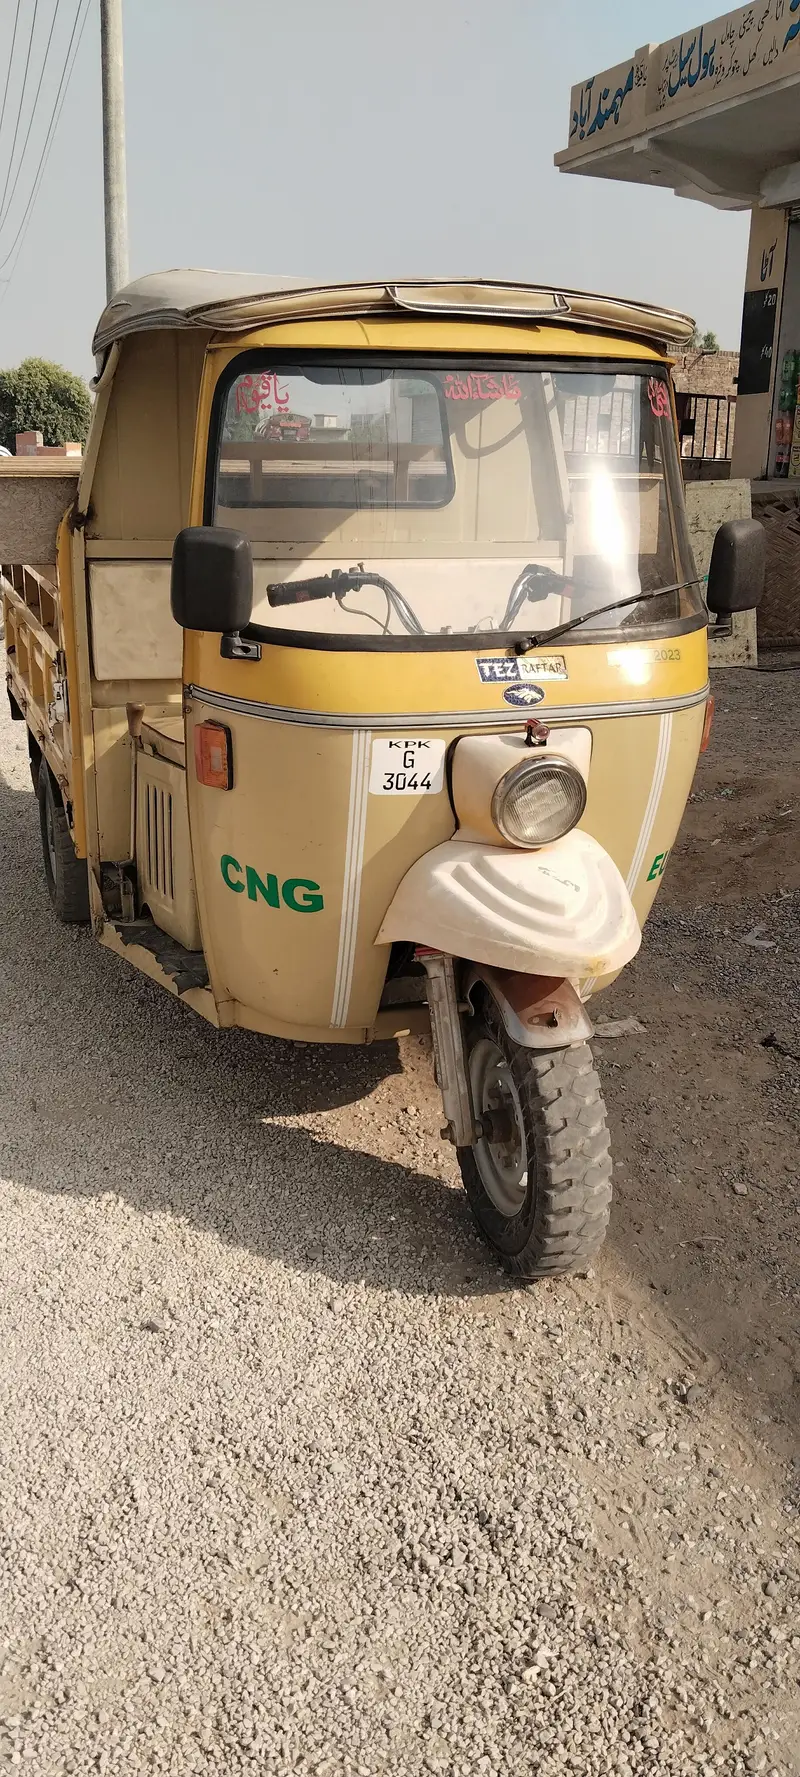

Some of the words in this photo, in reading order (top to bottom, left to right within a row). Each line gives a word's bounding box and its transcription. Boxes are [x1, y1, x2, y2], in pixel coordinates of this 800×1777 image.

[688, 26, 717, 89] ہول
[668, 37, 696, 98] سیل
[654, 649, 681, 661] 2023
[479, 662, 517, 677] TEZ
[522, 662, 562, 674] RAFTAR
[388, 740, 431, 749] KPK
[403, 750, 415, 769] G
[382, 772, 432, 791] 3044
[220, 854, 324, 913] CNG
